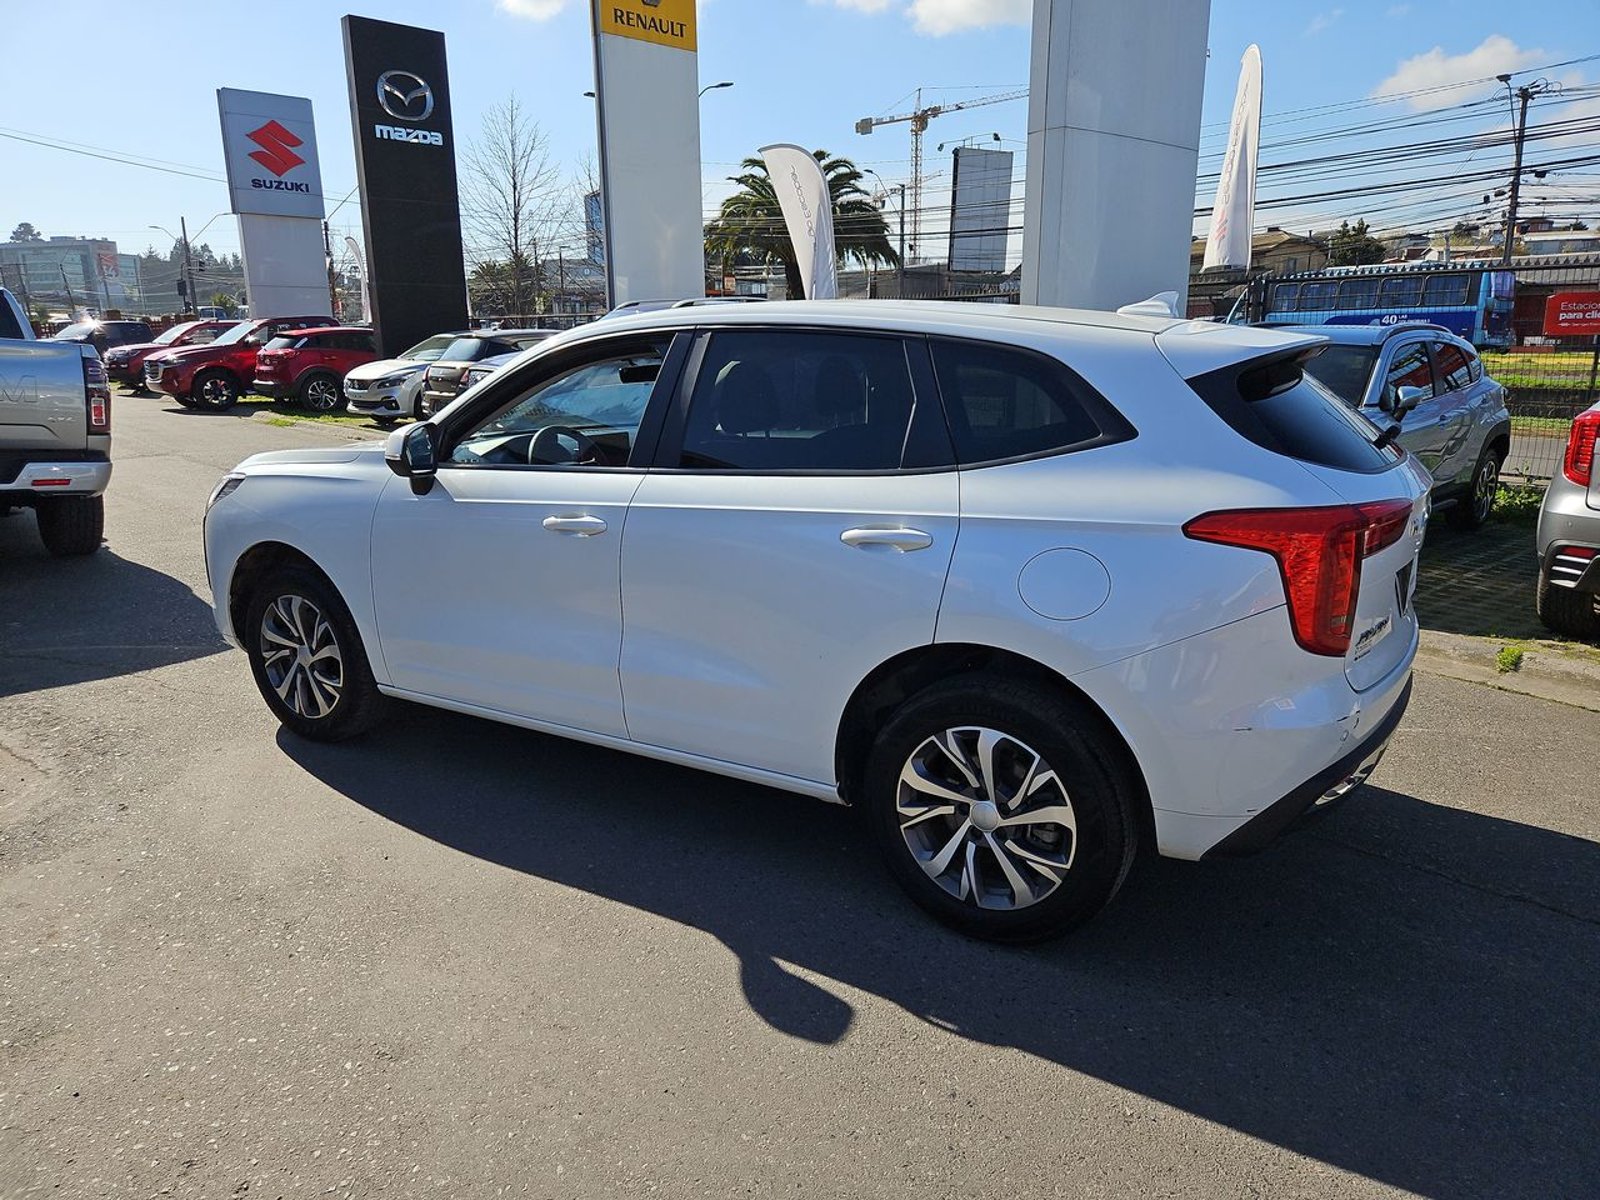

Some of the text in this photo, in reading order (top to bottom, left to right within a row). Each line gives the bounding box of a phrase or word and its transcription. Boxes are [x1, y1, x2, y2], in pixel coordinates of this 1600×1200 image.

[613, 7, 687, 38] RENAULT
[251, 178, 310, 193] SUZUKI
[1560, 301, 1600, 311] Estacio
[1381, 314, 1398, 325] 40
[1559, 312, 1584, 321] para
